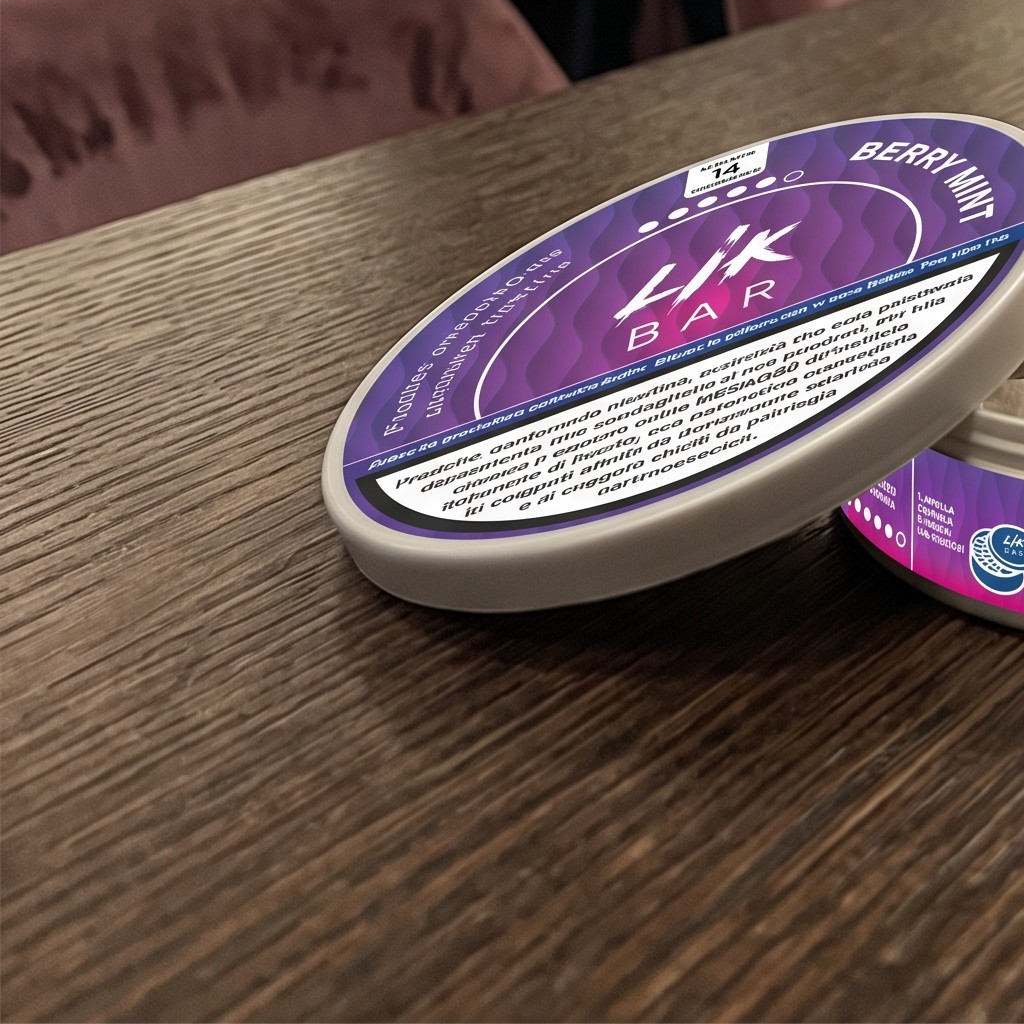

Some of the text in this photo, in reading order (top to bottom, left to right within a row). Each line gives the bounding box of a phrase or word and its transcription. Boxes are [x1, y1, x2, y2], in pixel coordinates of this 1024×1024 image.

[711, 161, 741, 179] 14
[849, 141, 995, 224] BERRY MINT
[626, 279, 776, 352] BAR
[547, 459, 566, 474] di
[519, 502, 532, 511] e
